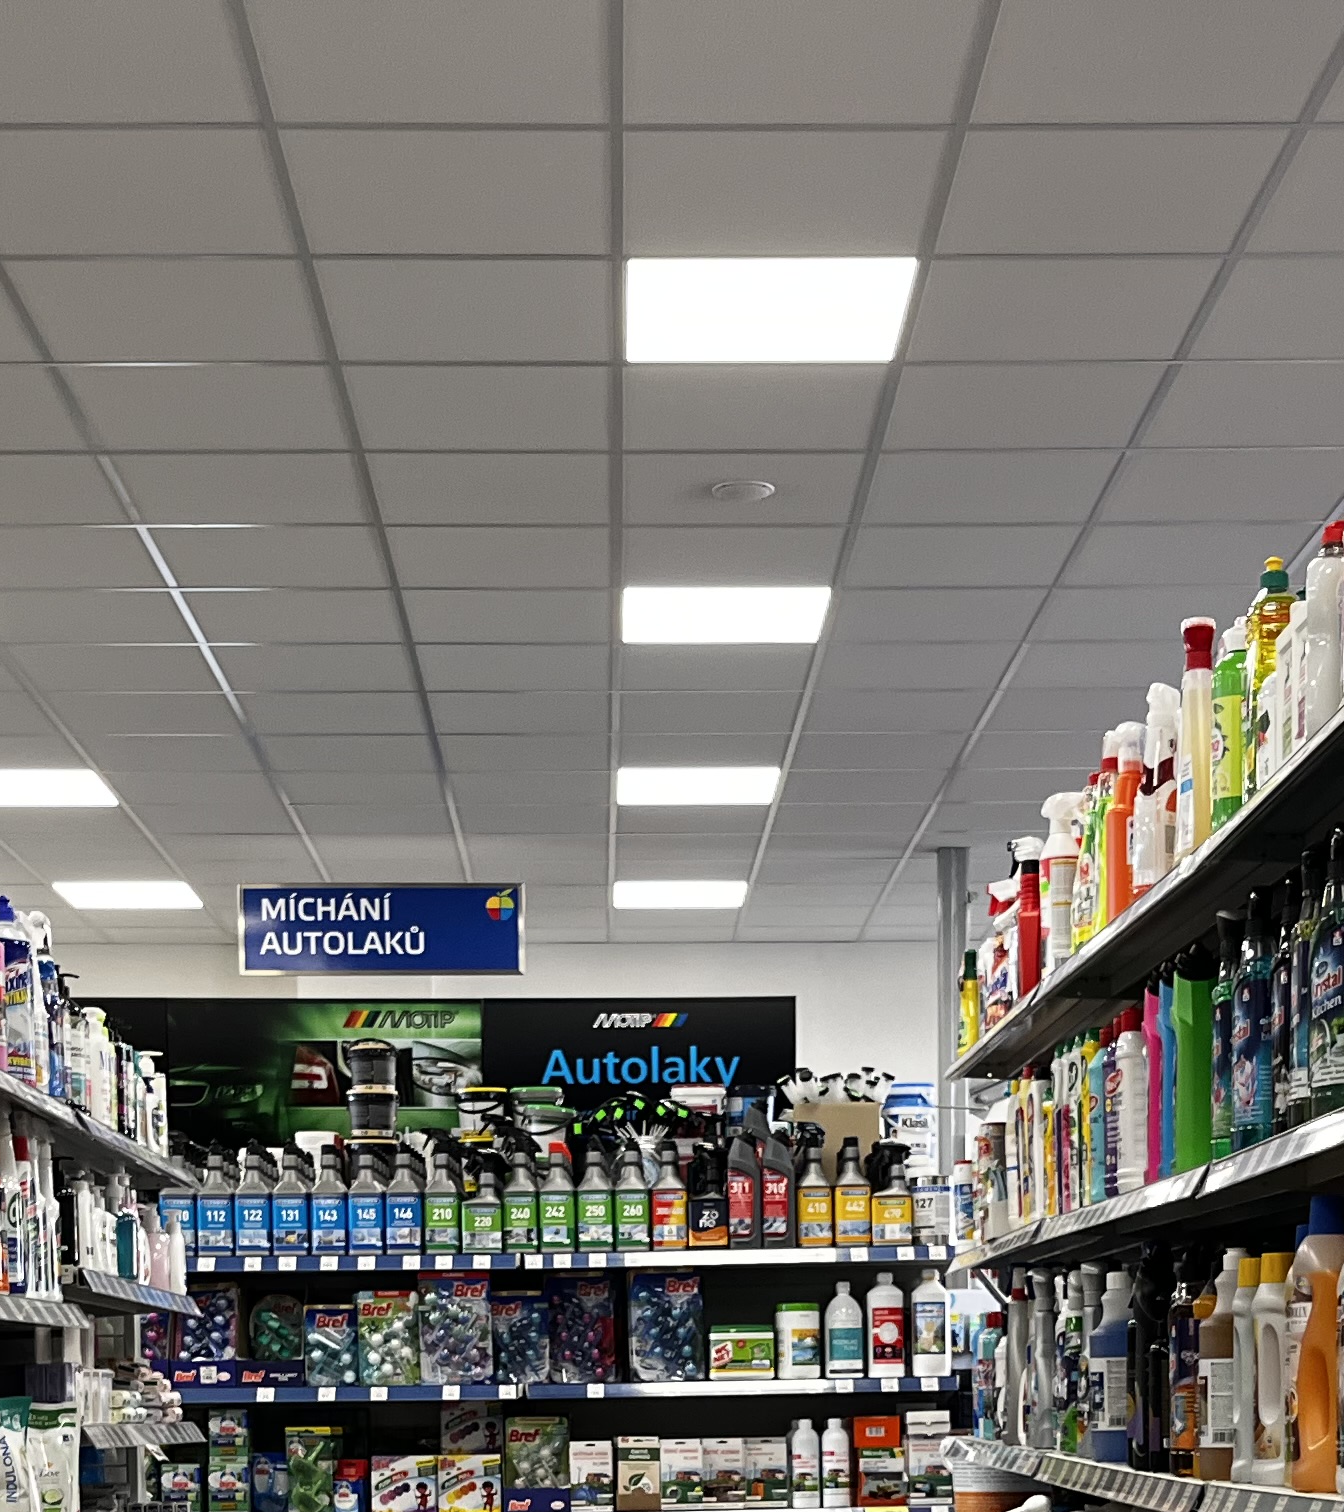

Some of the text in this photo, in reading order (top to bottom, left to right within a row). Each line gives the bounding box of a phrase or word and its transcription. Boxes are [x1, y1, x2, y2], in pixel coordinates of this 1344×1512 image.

[260, 893, 391, 922] MÍCHÁNÍ
[259, 926, 426, 956] AUTOLAKŮ
[379, 1010, 455, 1029] MOTIP
[593, 1013, 655, 1029] MOTIP
[542, 1046, 741, 1087] Autolaky
[730, 1181, 751, 1194] 311
[206, 1210, 226, 1222] 112
[243, 1209, 263, 1221] 122
[280, 1209, 300, 1222] 131
[318, 1210, 338, 1222] 143
[356, 1208, 377, 1220] 145
[394, 1208, 413, 1220] 146
[432, 1208, 453, 1220] 210
[510, 1207, 530, 1219] 240
[545, 1205, 566, 1218] 242
[585, 1205, 606, 1217] 250
[623, 1205, 643, 1217] 260
[474, 1216, 492, 1227] 220
[454, 1282, 487, 1298] Bref
[361, 1301, 394, 1317] Bref
[316, 1314, 348, 1330] Bref
[509, 1428, 540, 1443] Bref
